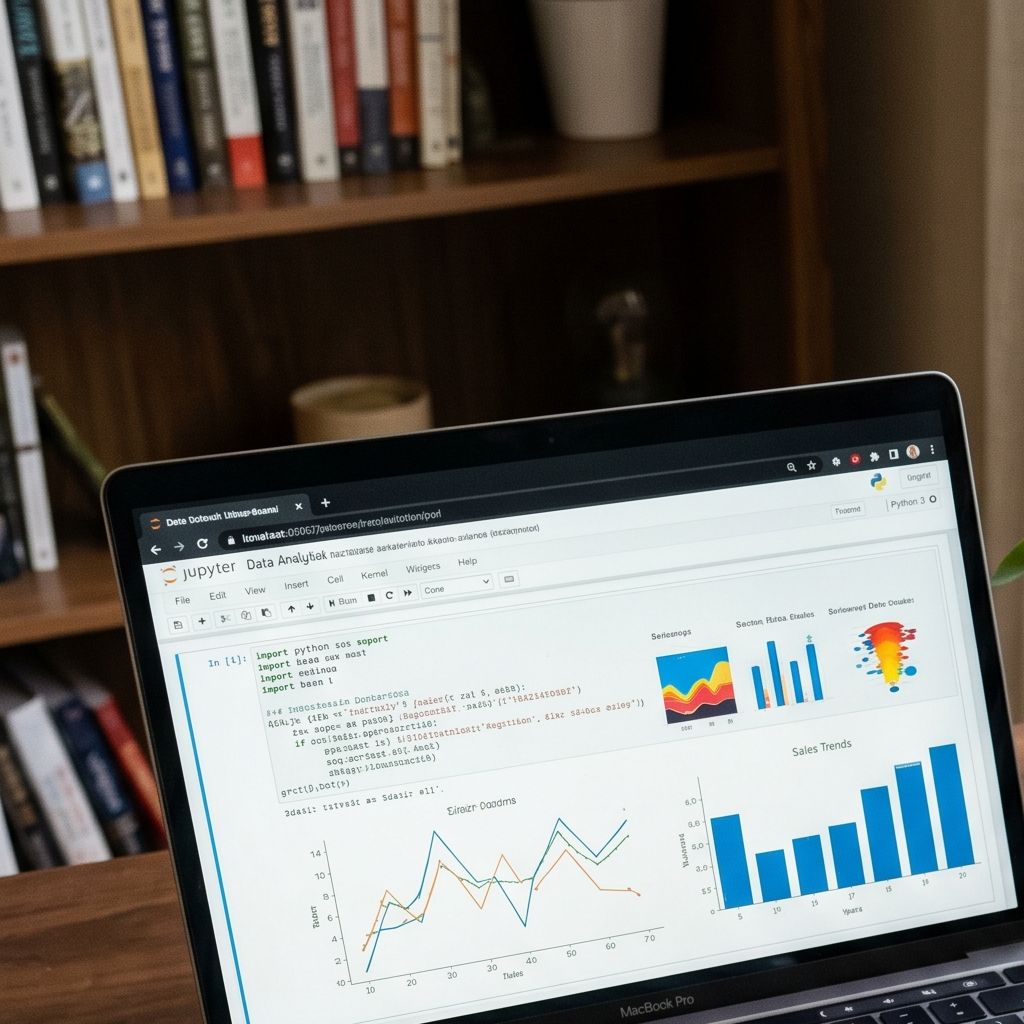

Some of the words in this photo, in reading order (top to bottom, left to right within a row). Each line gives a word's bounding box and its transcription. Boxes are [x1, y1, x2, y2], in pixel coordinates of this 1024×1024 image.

[891, 498, 918, 510] Python
[920, 496, 926, 505] 3
[247, 559, 274, 571] Data
[175, 596, 190, 606] File
[209, 591, 227, 601] Edit
[245, 586, 266, 596] View
[285, 580, 309, 590] Insert
[327, 575, 344, 584] Cell
[361, 569, 388, 580] Kernel
[458, 557, 478, 567] Help
[256, 648, 288, 660] import
[294, 643, 330, 656] python
[258, 659, 291, 672] import
[262, 682, 295, 694] import
[792, 744, 818, 757] Sales
[820, 739, 852, 753] Trends
[738, 912, 743, 920] 5
[959, 871, 967, 879] 20
[327, 913, 334, 921] 6
[332, 935, 338, 943] 4
[335, 956, 341, 965] 2
[366, 985, 376, 994] 10
[407, 978, 418, 987] 20
[447, 970, 458, 980] 30
[487, 963, 498, 973] 30
[526, 955, 537, 965] 40
[566, 948, 577, 958] 50
[605, 941, 616, 951] 60
[644, 933, 655, 943] 70
[620, 998, 673, 1019] MacBook
[674, 994, 695, 1009] Pro
